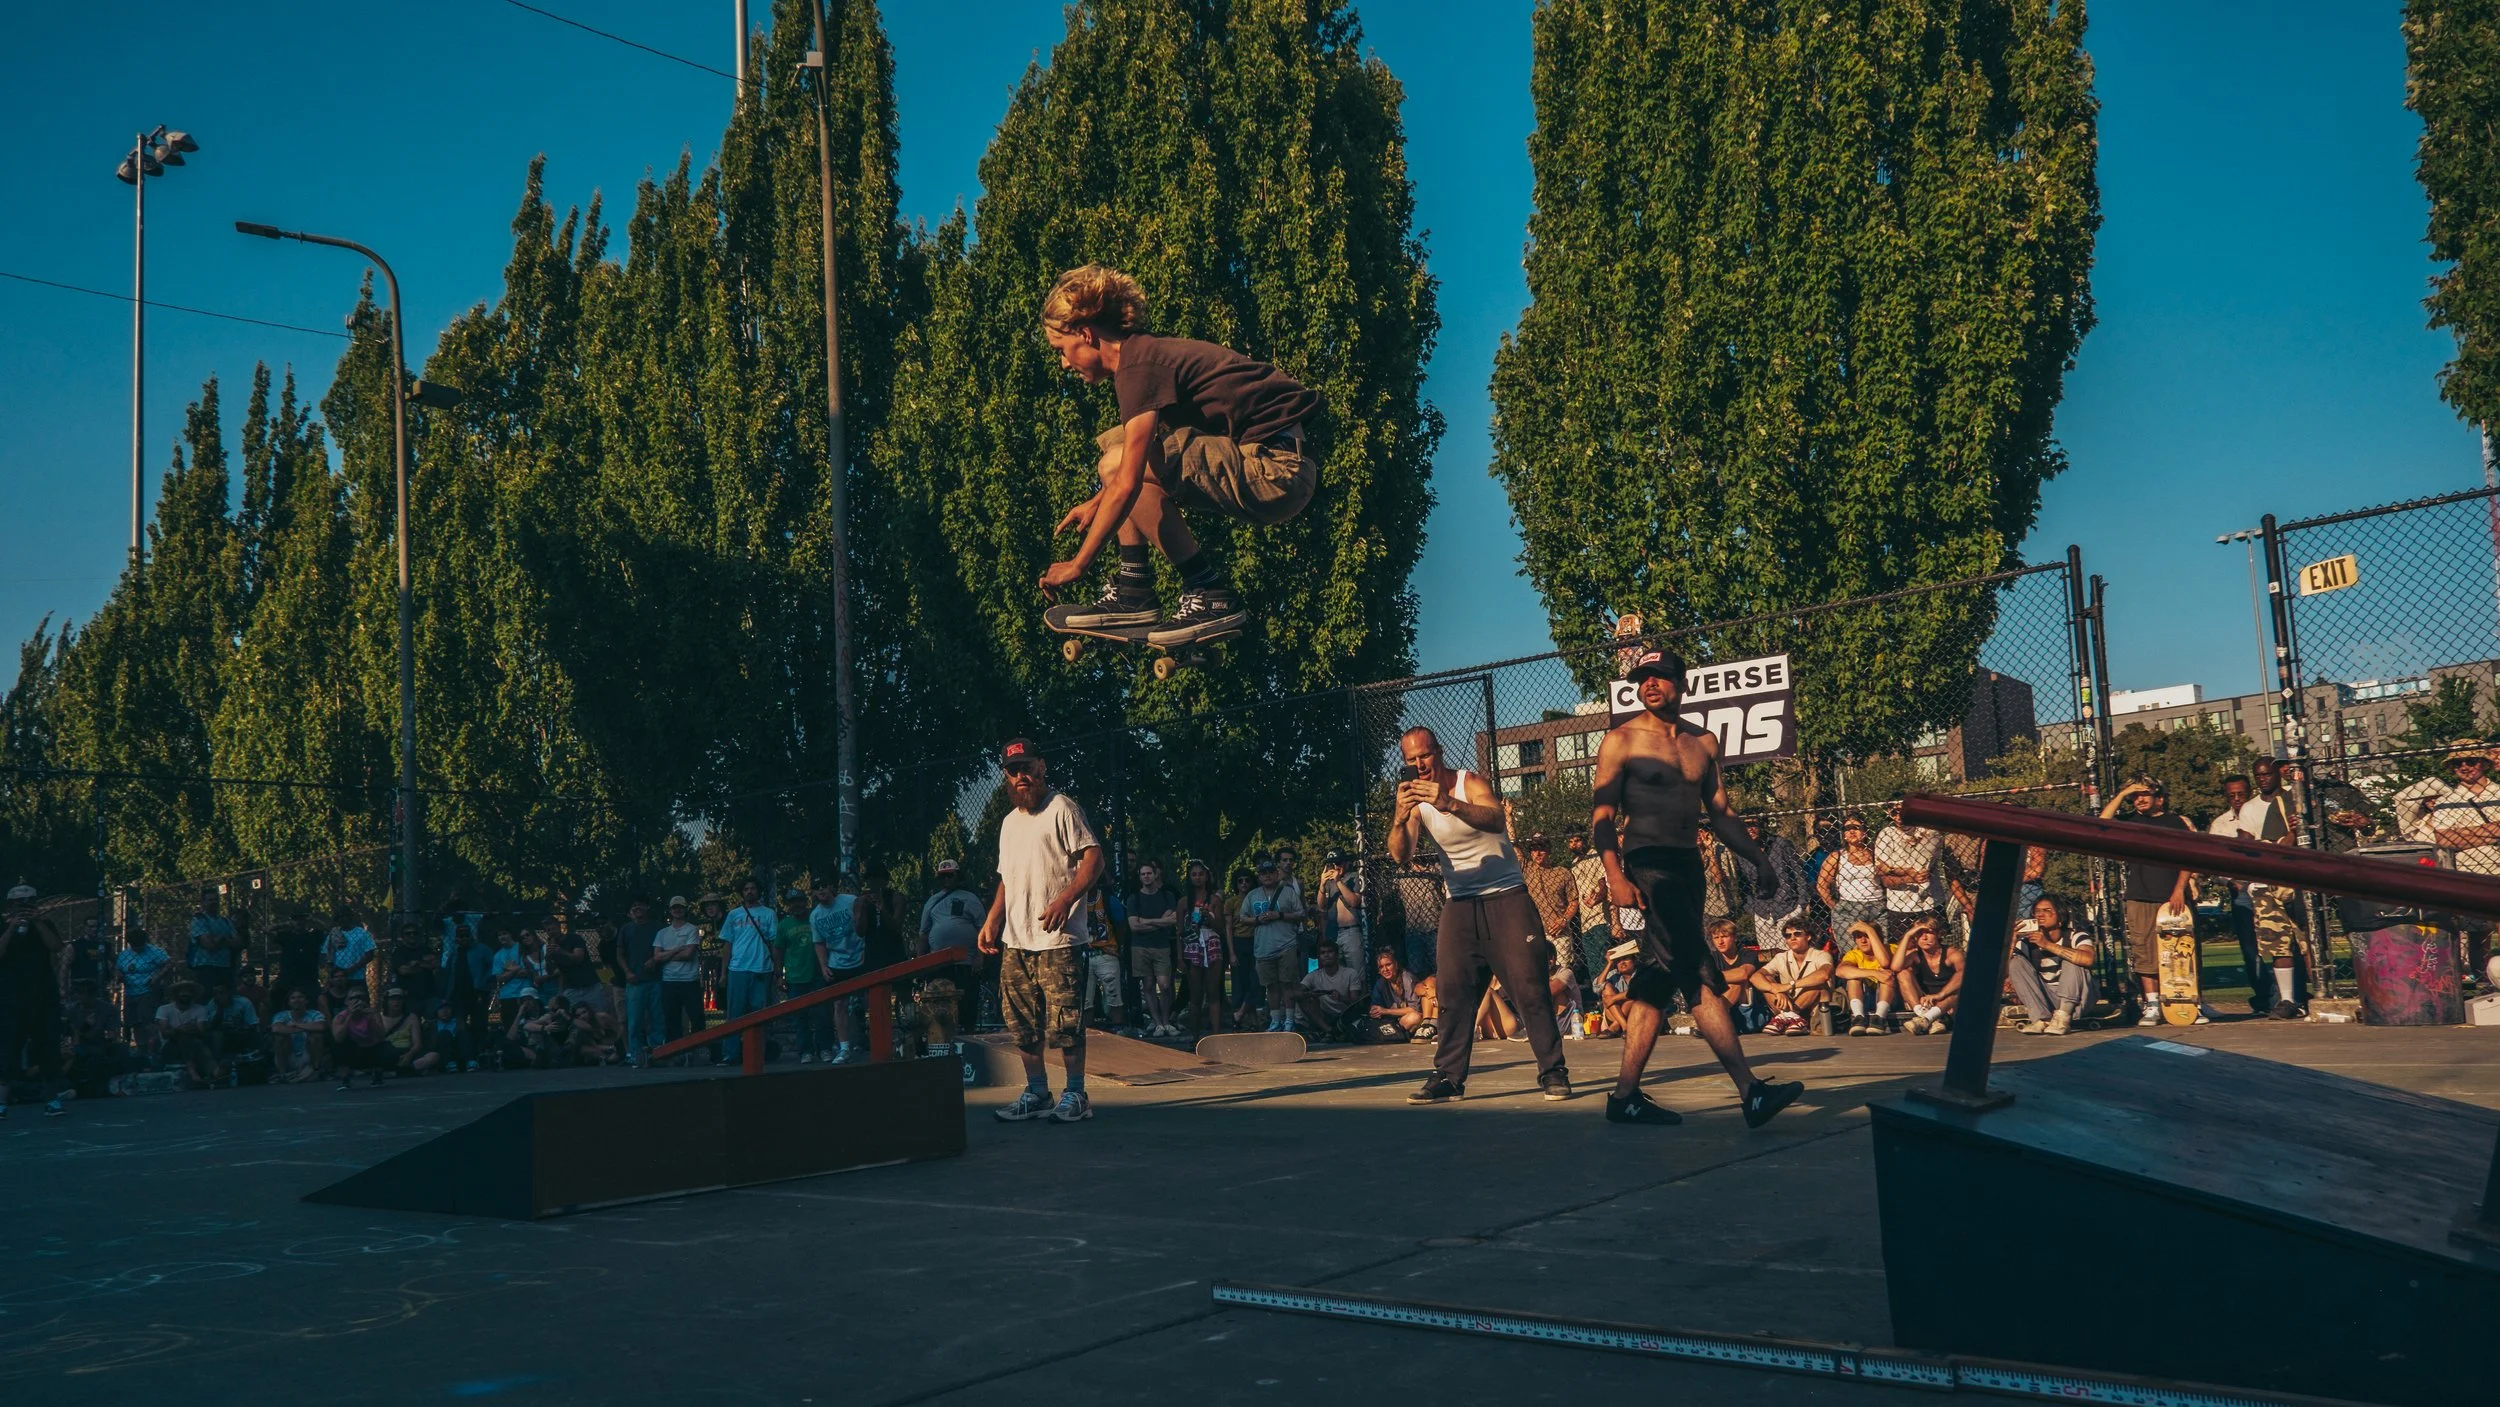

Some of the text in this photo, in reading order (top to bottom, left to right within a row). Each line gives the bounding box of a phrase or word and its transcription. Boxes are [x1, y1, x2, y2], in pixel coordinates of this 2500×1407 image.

[2310, 558, 2347, 591] EXIT
[1616, 663, 1783, 707] CVERSE
[1314, 1303, 1321, 1311] 10
[1455, 1320, 1462, 1328] 10
[1476, 1320, 1492, 1331] 2
[1616, 1339, 1624, 1348] 10
[1640, 1340, 1659, 1350] 3
[1803, 1360, 1812, 1369] 10
[2029, 1382, 2040, 1393] 10
[2049, 1386, 2060, 1394] 11
[2064, 1386, 2089, 1398] 5
